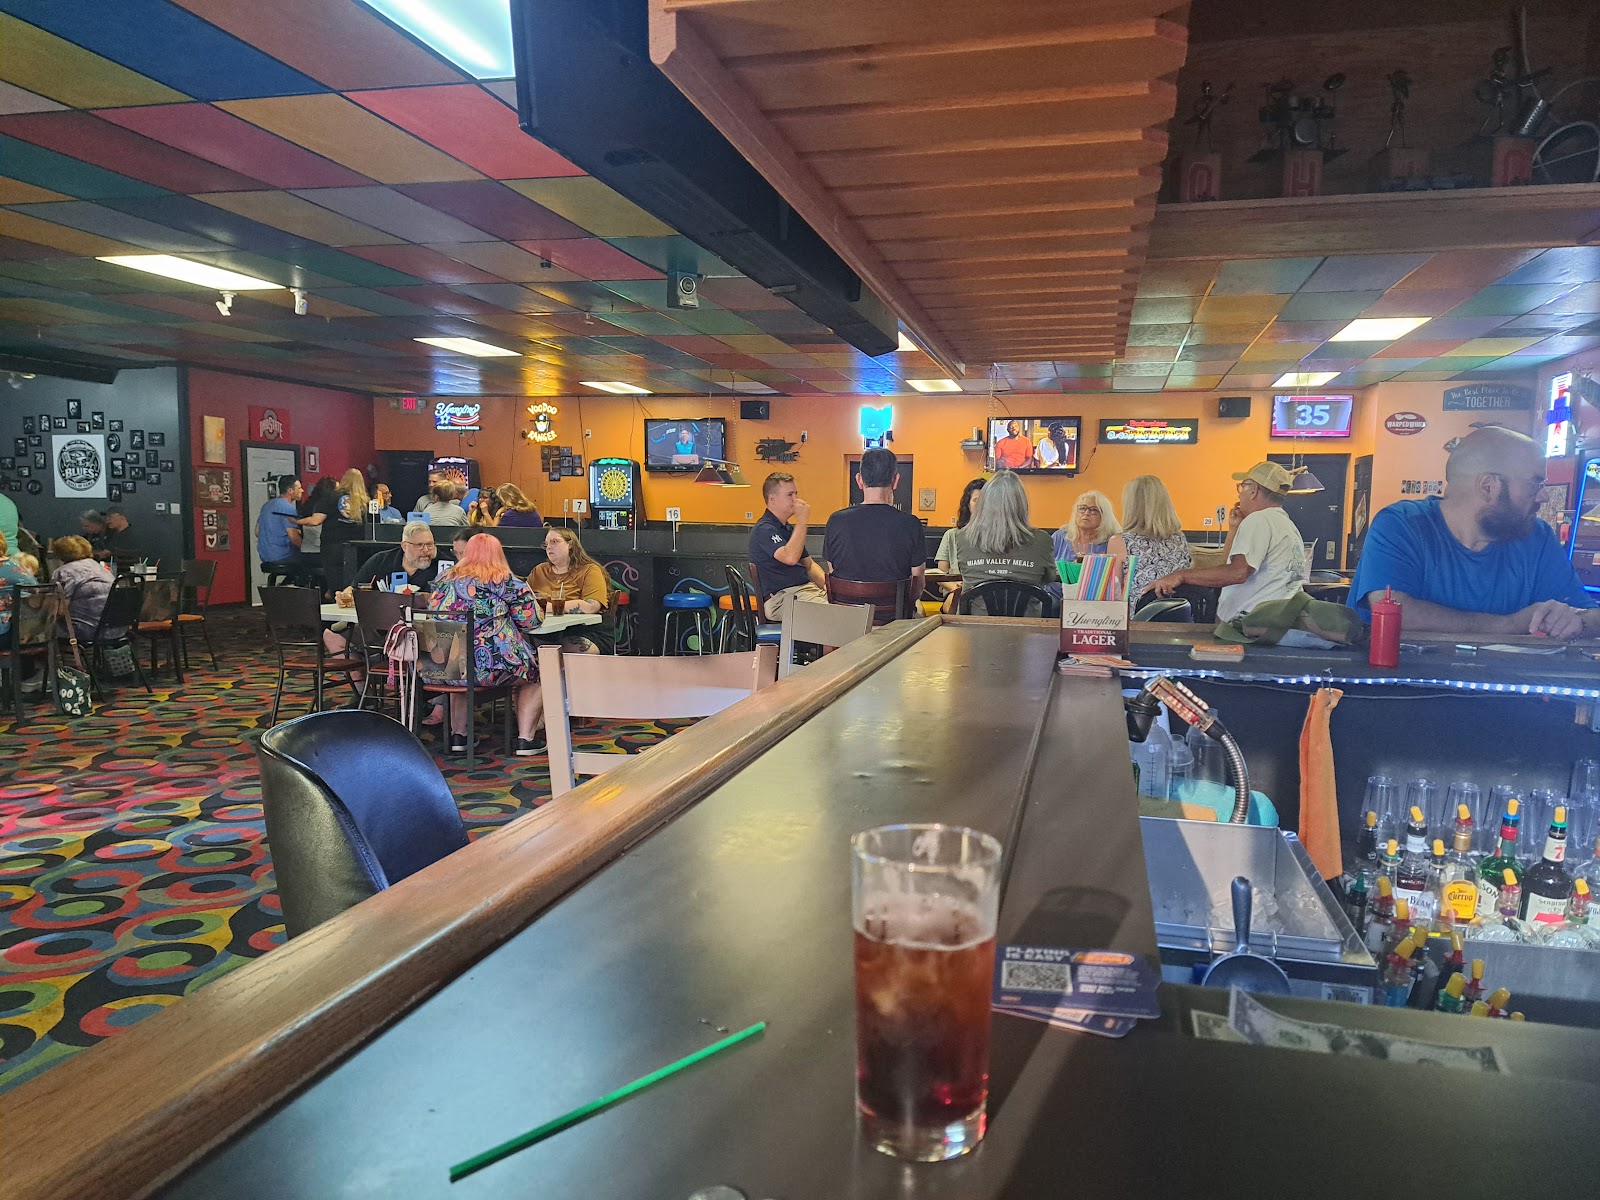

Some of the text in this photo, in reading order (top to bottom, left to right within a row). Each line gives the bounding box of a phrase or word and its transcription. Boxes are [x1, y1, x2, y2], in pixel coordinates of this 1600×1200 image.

[402, 398, 416, 409] EXIT
[1465, 396, 1511, 408] TOGETHER
[527, 402, 558, 415] VOODOO
[1296, 404, 1330, 426] 35
[527, 430, 558, 442] RANGER
[65, 468, 95, 480] BLUES
[370, 502, 378, 512] 15
[668, 509, 679, 519] 16
[1217, 507, 1225, 522] 18
[966, 559, 985, 567] MIAMI
[1012, 559, 1035, 568] MEALS
[1067, 611, 1125, 628] Yuengling
[1072, 634, 1116, 646] LAGER
[1554, 846, 1563, 860] 7
[1447, 890, 1474, 901] Cuervo
[1409, 895, 1431, 910] BEAM
